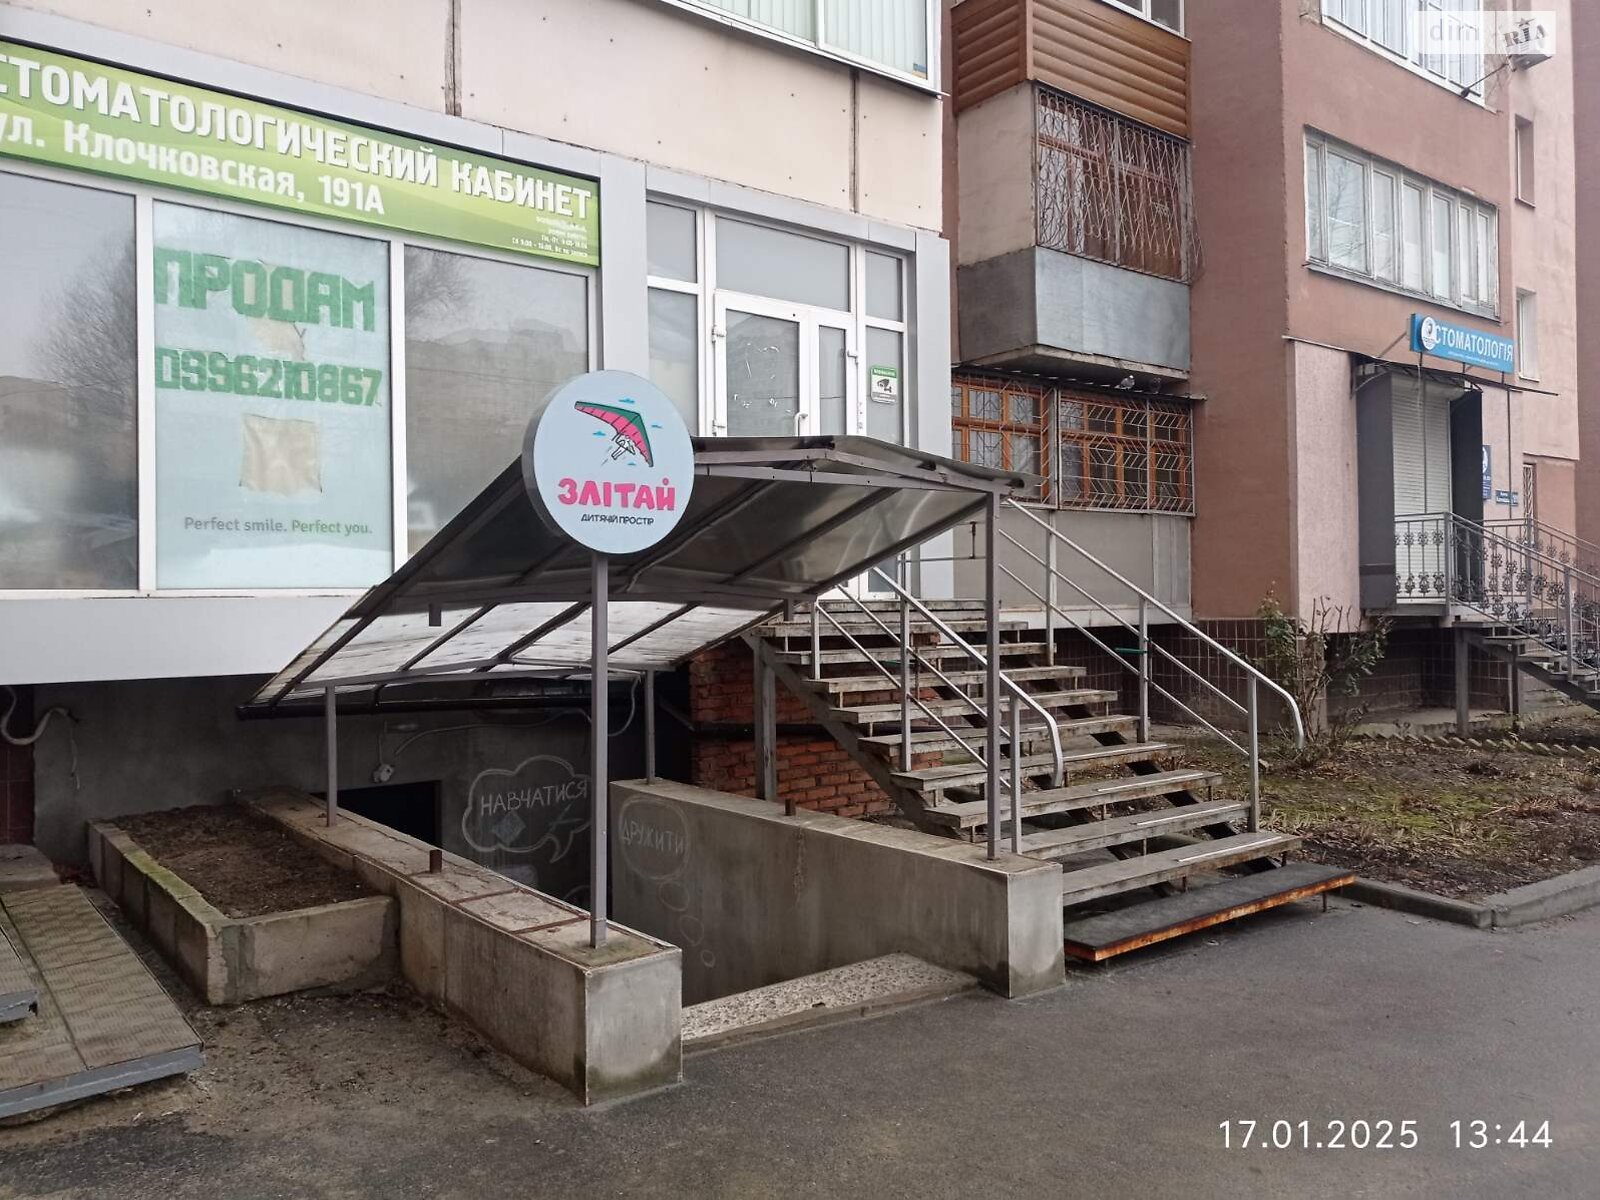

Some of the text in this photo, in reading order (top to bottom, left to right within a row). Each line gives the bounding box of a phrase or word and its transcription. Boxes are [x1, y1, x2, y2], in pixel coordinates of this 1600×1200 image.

[64, 119, 306, 203] Клочковская,
[318, 174, 385, 216] 191А
[452, 159, 591, 219] КАБИНЕТ
[153, 246, 376, 333] ПРОДАМ
[1434, 325, 1513, 362] СТОМАТОЛОГІЯ
[153, 346, 383, 407] 0996210867
[557, 477, 676, 511] ЗЛІТАЙ
[184, 517, 373, 537] Perfect smile. Perfect you.
[480, 779, 589, 816] НАВЧАТИСЯ
[621, 817, 685, 854] ДРУЖИТИ
